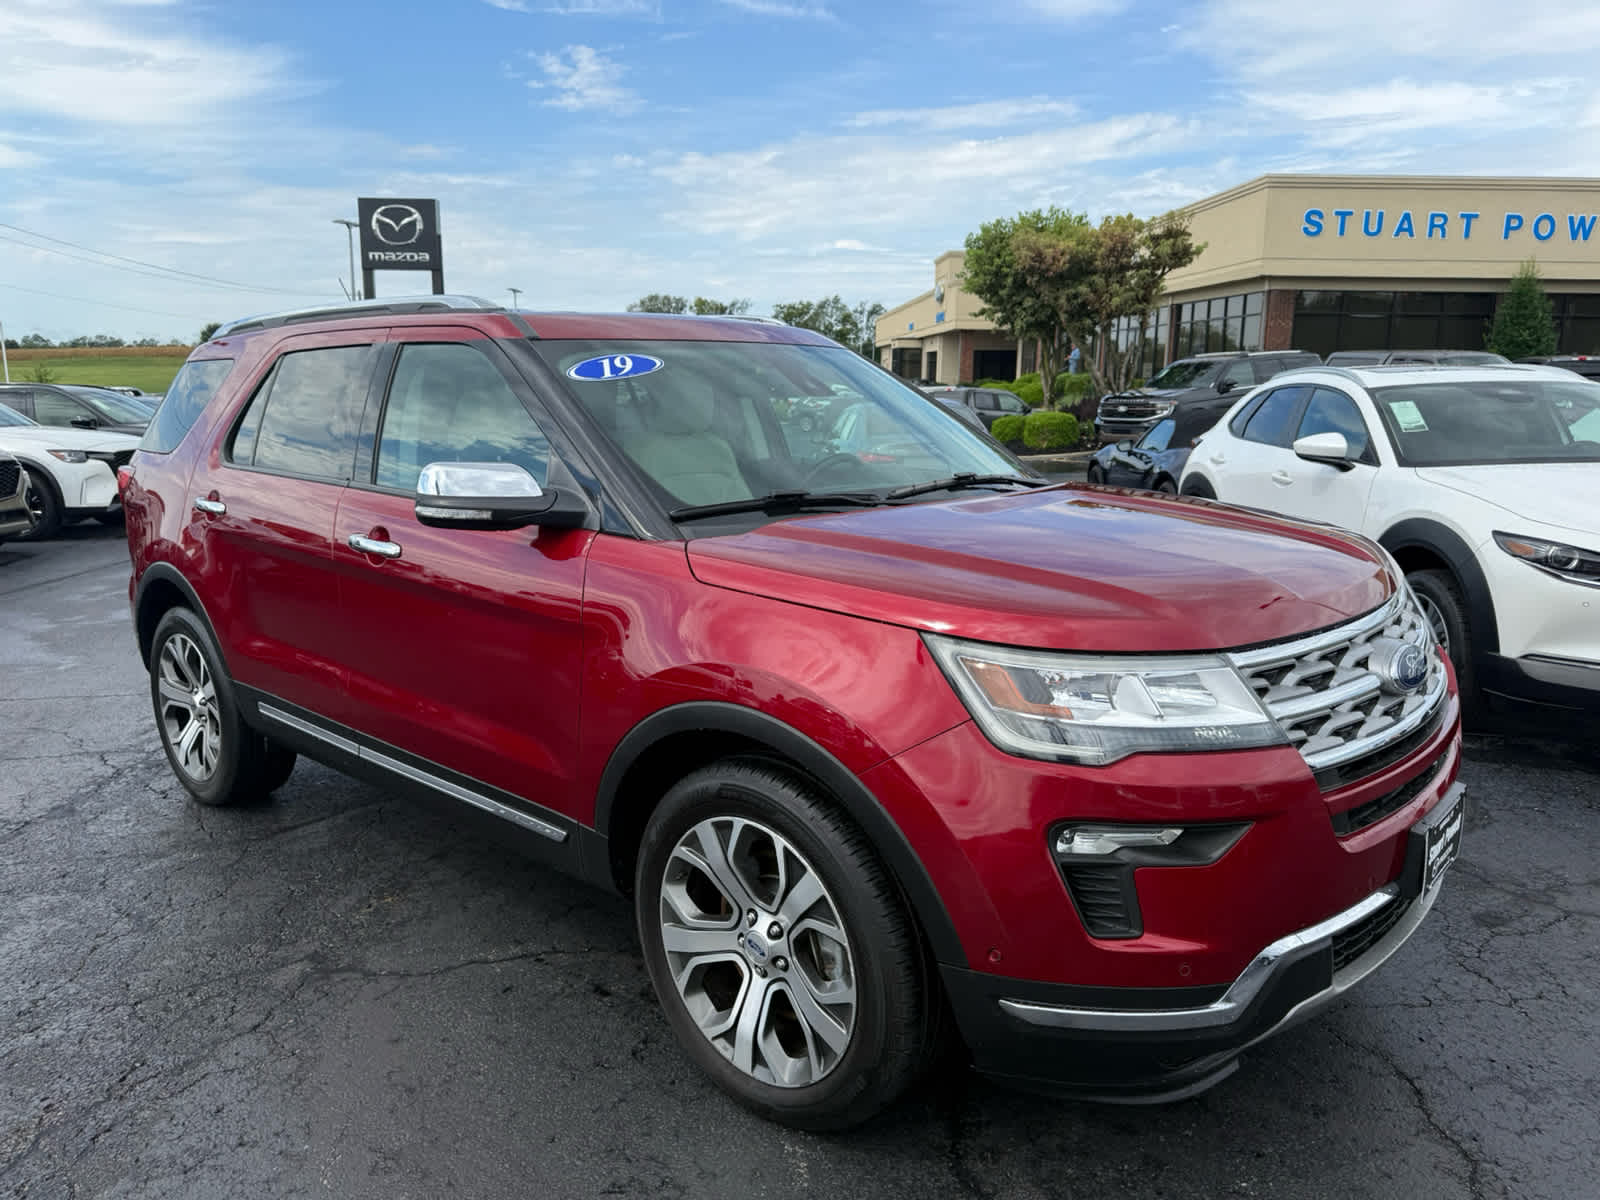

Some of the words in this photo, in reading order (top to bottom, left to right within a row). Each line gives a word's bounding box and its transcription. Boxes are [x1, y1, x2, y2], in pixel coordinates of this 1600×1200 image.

[1302, 209, 1480, 239] STUART
[1503, 213, 1598, 241] POW
[368, 251, 430, 261] mazda
[598, 355, 633, 379] 19
